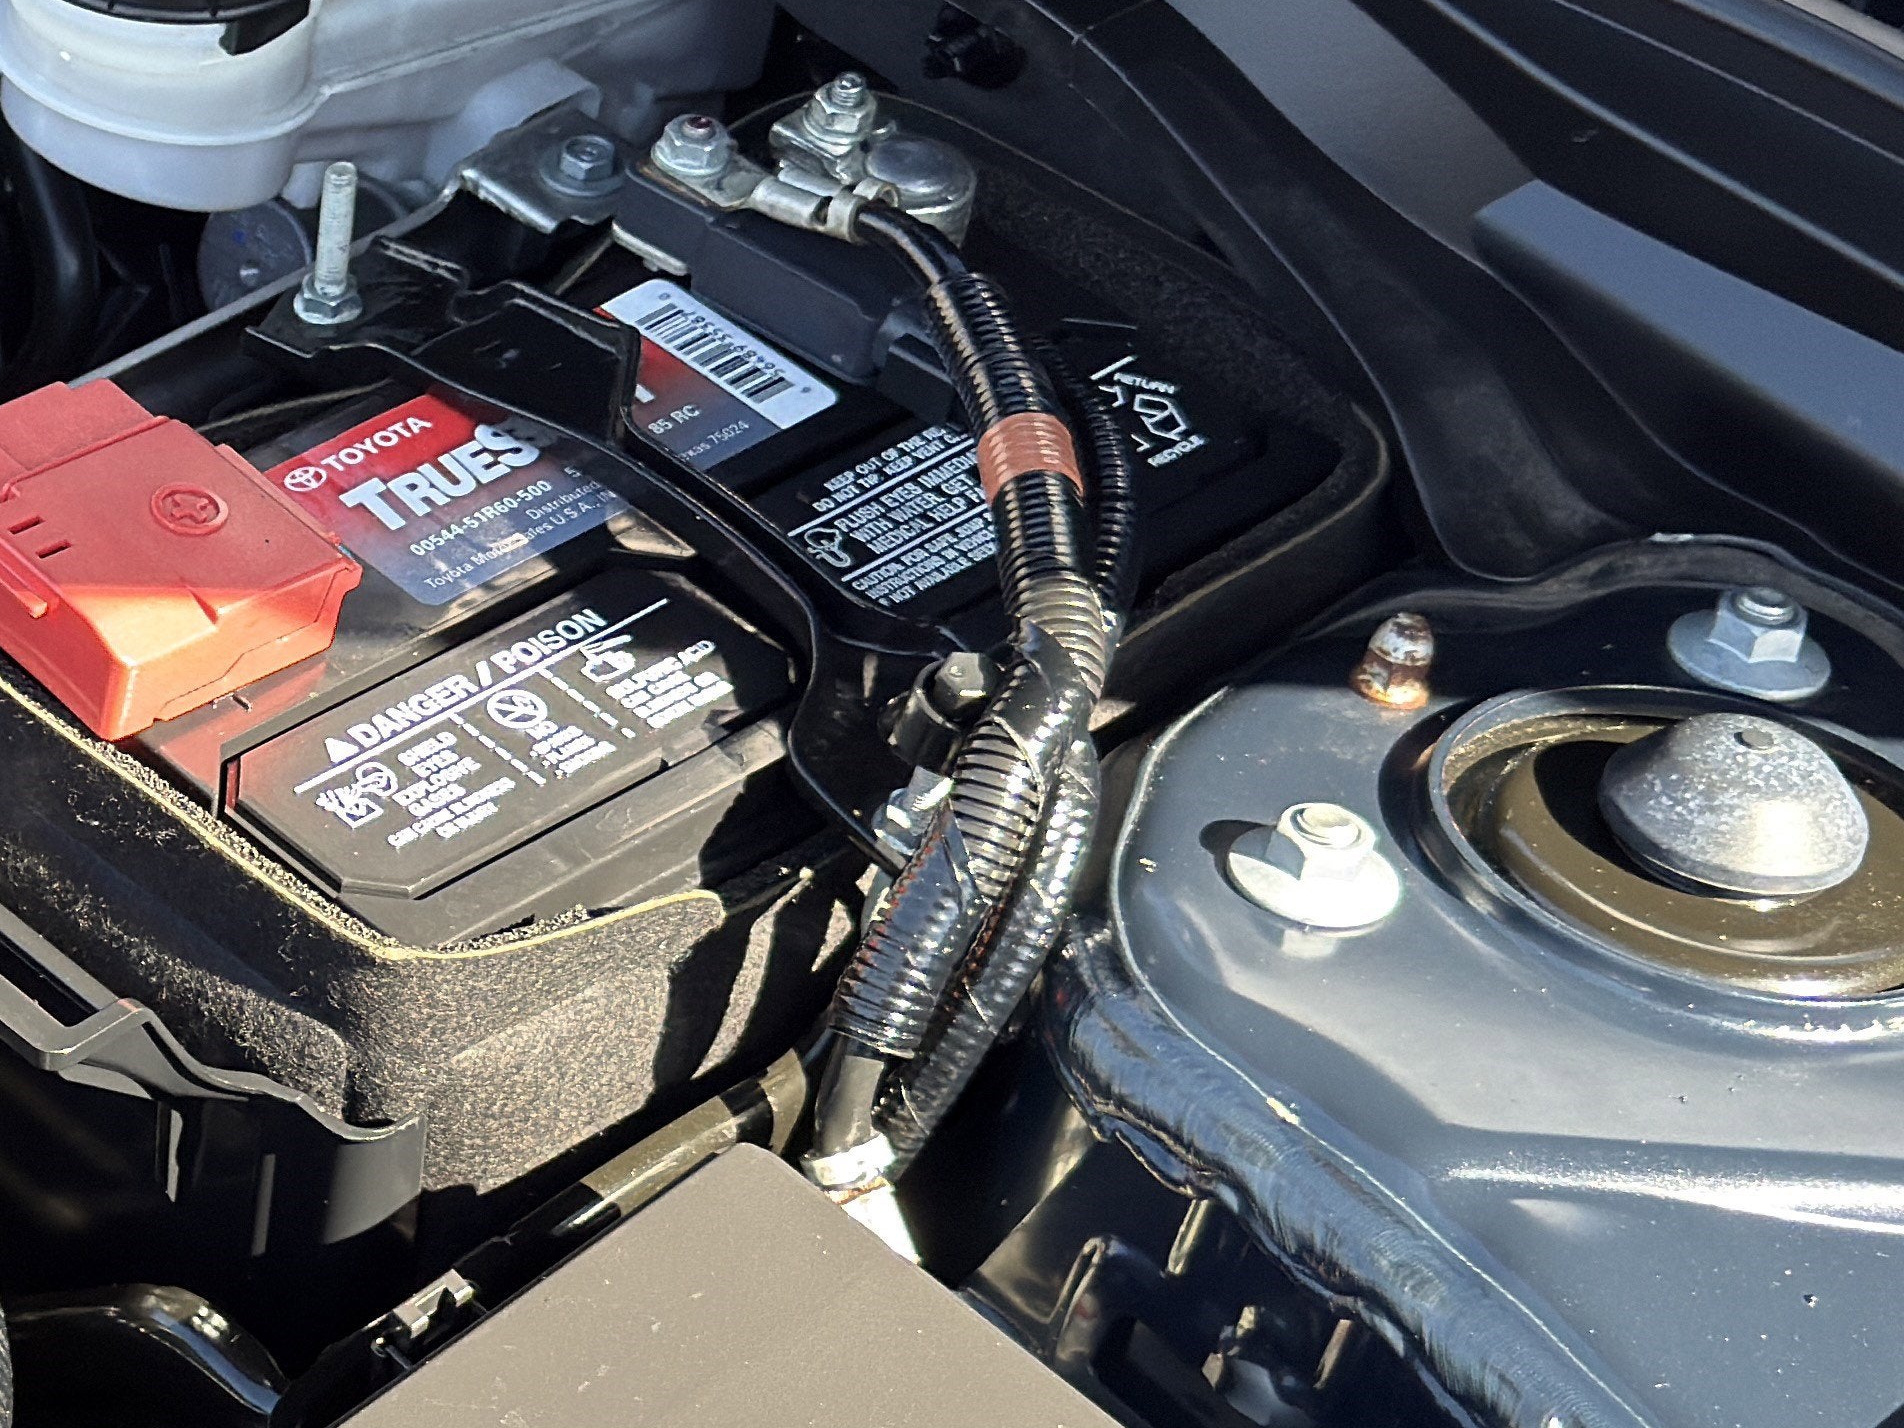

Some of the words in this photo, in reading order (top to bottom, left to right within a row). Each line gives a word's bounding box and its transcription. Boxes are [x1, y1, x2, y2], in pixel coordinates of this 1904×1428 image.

[321, 416, 432, 473] TOYOTA
[648, 419, 671, 435] 85
[670, 404, 701, 422] RC
[339, 423, 540, 531] TRUES
[527, 479, 601, 521] Distributed
[824, 471, 856, 492] KEEP
[410, 480, 552, 557] 00544-51R60-500
[834, 500, 888, 533] FLUSH
[883, 482, 923, 507] EYES
[849, 515, 897, 542] WITH
[941, 474, 974, 496] GET
[867, 519, 934, 555] MEDICAL
[927, 496, 968, 524] HELP
[423, 556, 474, 590] Toyota
[347, 674, 480, 749] DANGER
[491, 609, 608, 672] POISON
